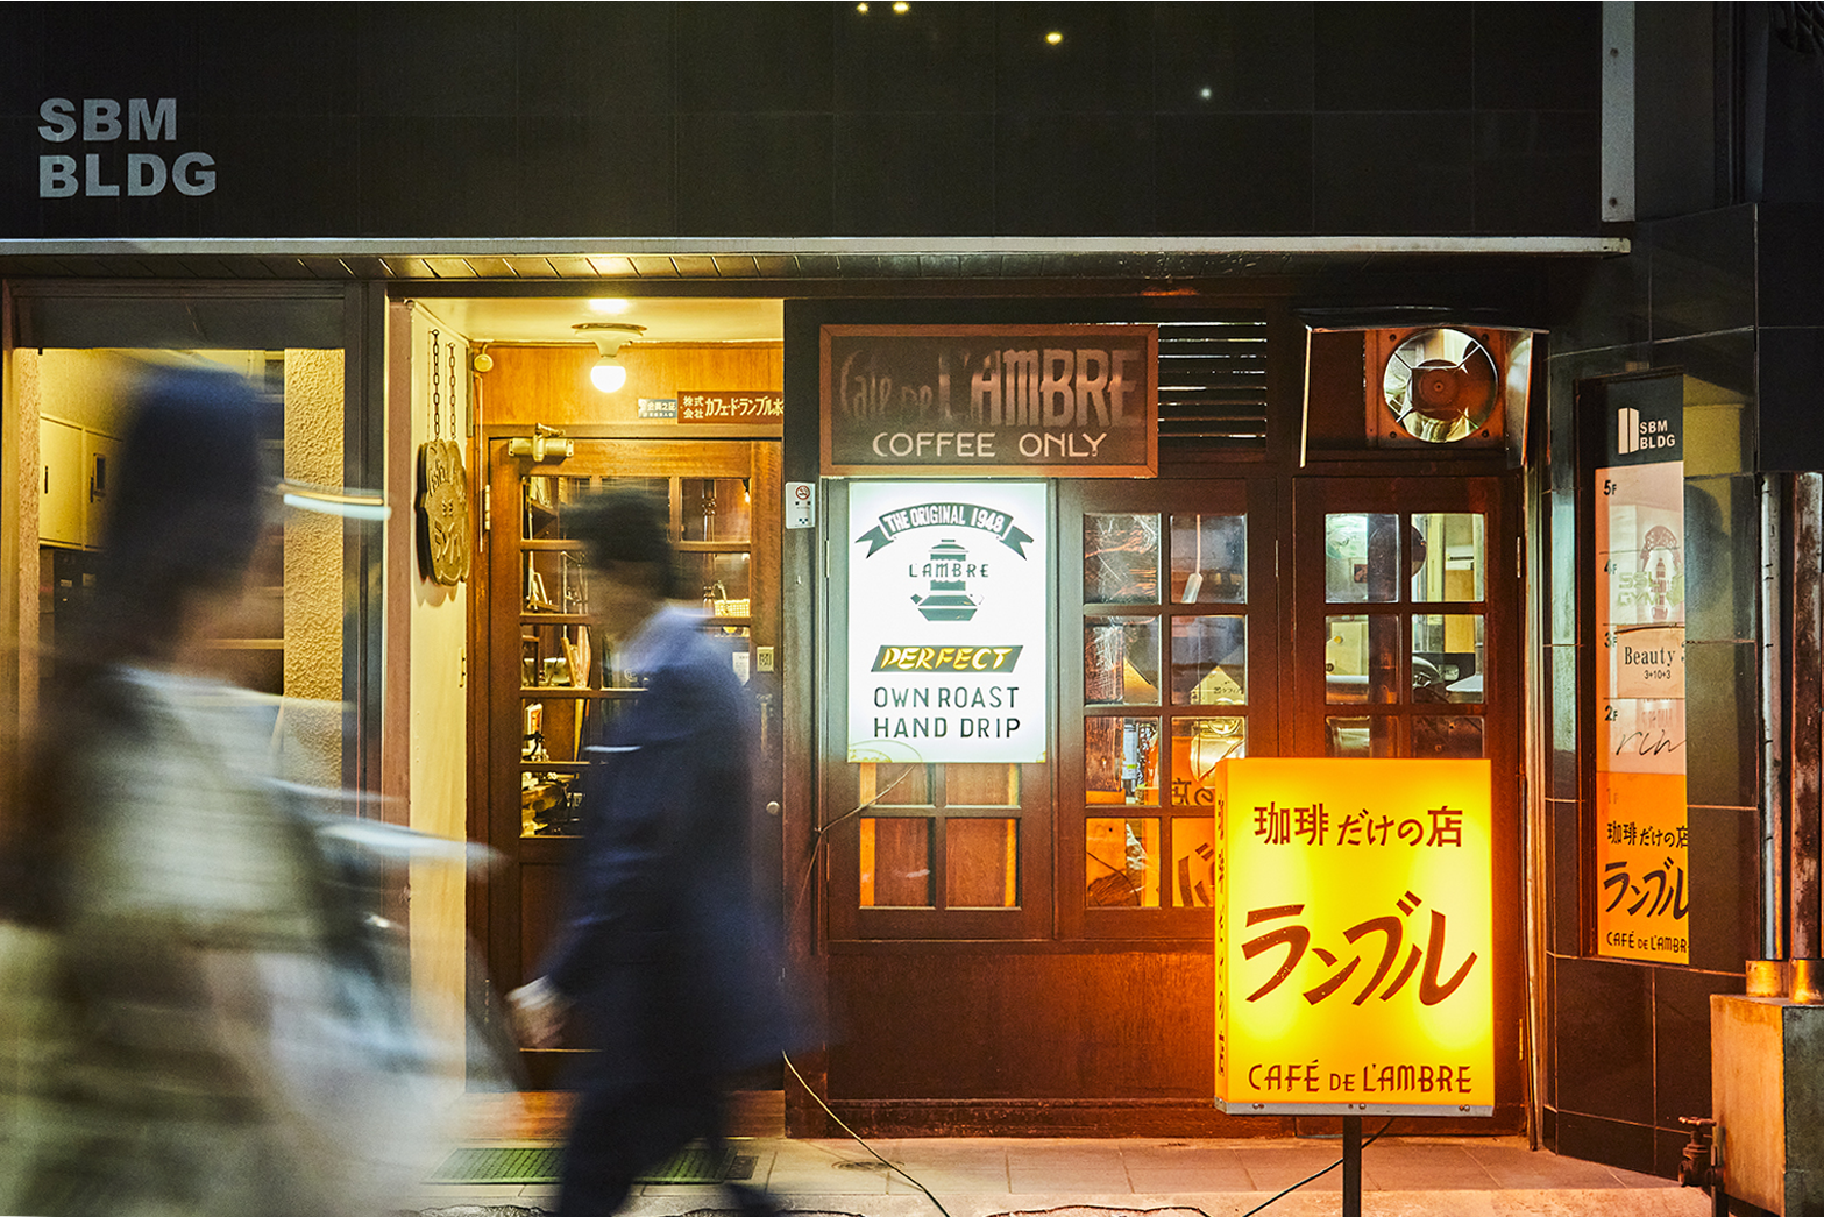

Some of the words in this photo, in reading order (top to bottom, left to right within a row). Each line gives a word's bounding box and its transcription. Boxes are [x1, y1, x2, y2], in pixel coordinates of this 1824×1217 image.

[38, 97, 178, 141] SBM
[39, 152, 217, 198] BLDG
[1639, 420, 1668, 435] SBM
[872, 431, 996, 458] COFFEE
[1019, 431, 1108, 458] ONLY
[1640, 435, 1676, 450] BLDG
[1603, 479, 1618, 496] 5F
[884, 510, 909, 533] THE
[909, 505, 966, 527] ORIGINAL
[971, 506, 1005, 533] 1948
[880, 646, 1014, 671] PERFECT
[1624, 646, 1676, 667] Beauty
[874, 686, 929, 709] OWN
[938, 686, 1020, 709] ROAST
[1604, 705, 1618, 721] 2F
[874, 718, 947, 738] HAND
[960, 718, 1021, 738] DRIP
[1254, 801, 1464, 848] 珈琲だけの店
[1606, 820, 1688, 848] 珈琲だけの店
[1604, 856, 1689, 920] ランブル
[1241, 890, 1477, 1006] ランブル
[1606, 931, 1635, 948] CAFÉ
[1248, 1059, 1320, 1093] CAFÉ
[1329, 1072, 1356, 1093] DE
[1362, 1061, 1472, 1093] L'AMBRE
